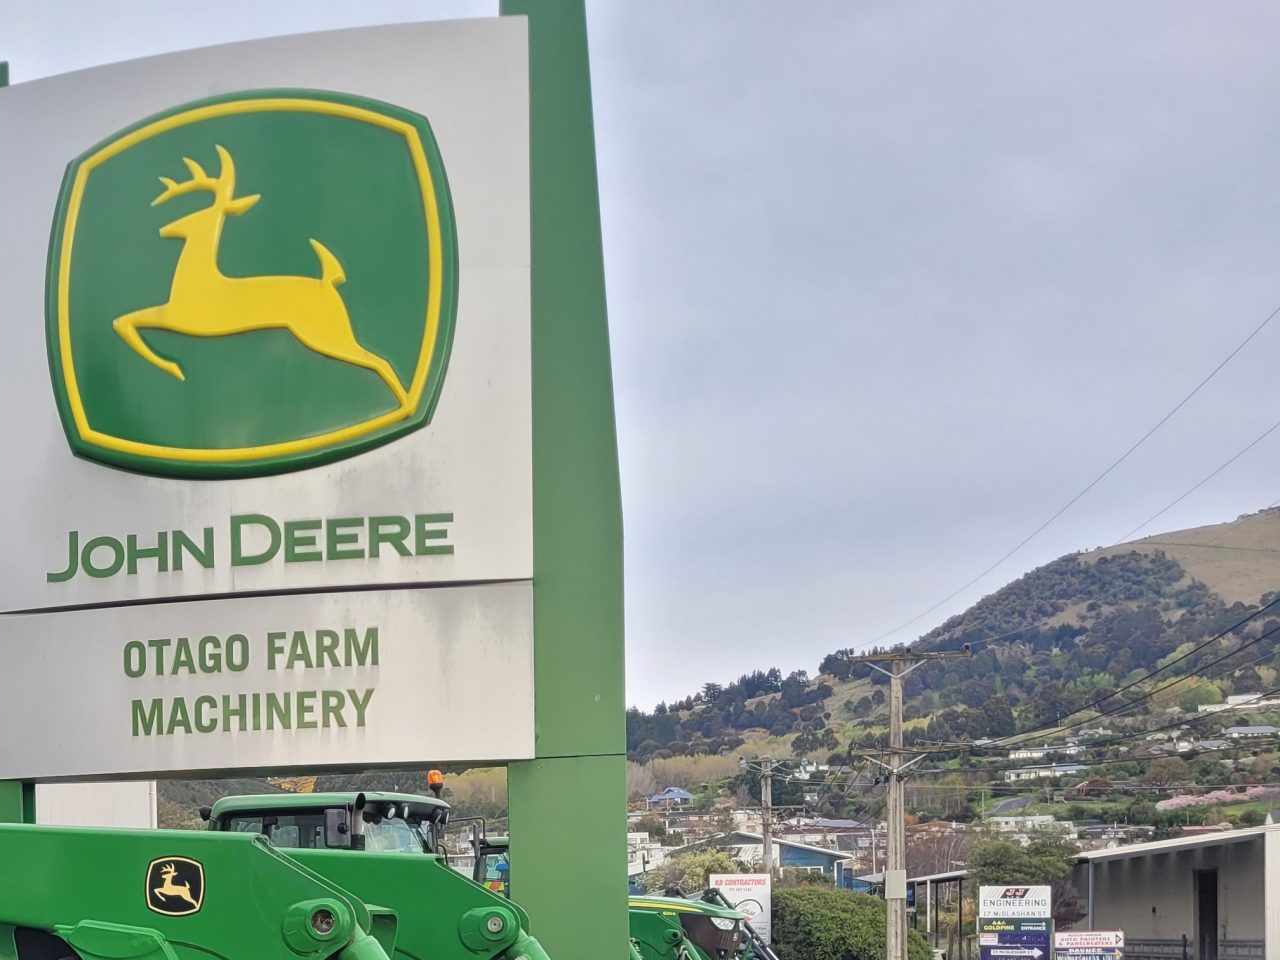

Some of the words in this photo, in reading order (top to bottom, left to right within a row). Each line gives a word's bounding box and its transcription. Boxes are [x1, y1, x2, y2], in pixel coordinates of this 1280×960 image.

[47, 527, 215, 583] JOHN
[230, 513, 455, 567] DEERE
[123, 633, 249, 679] OTAGO
[267, 627, 379, 670] FARM
[131, 688, 376, 737] MACHINERY
[983, 899, 1047, 907] ENGINEERING
